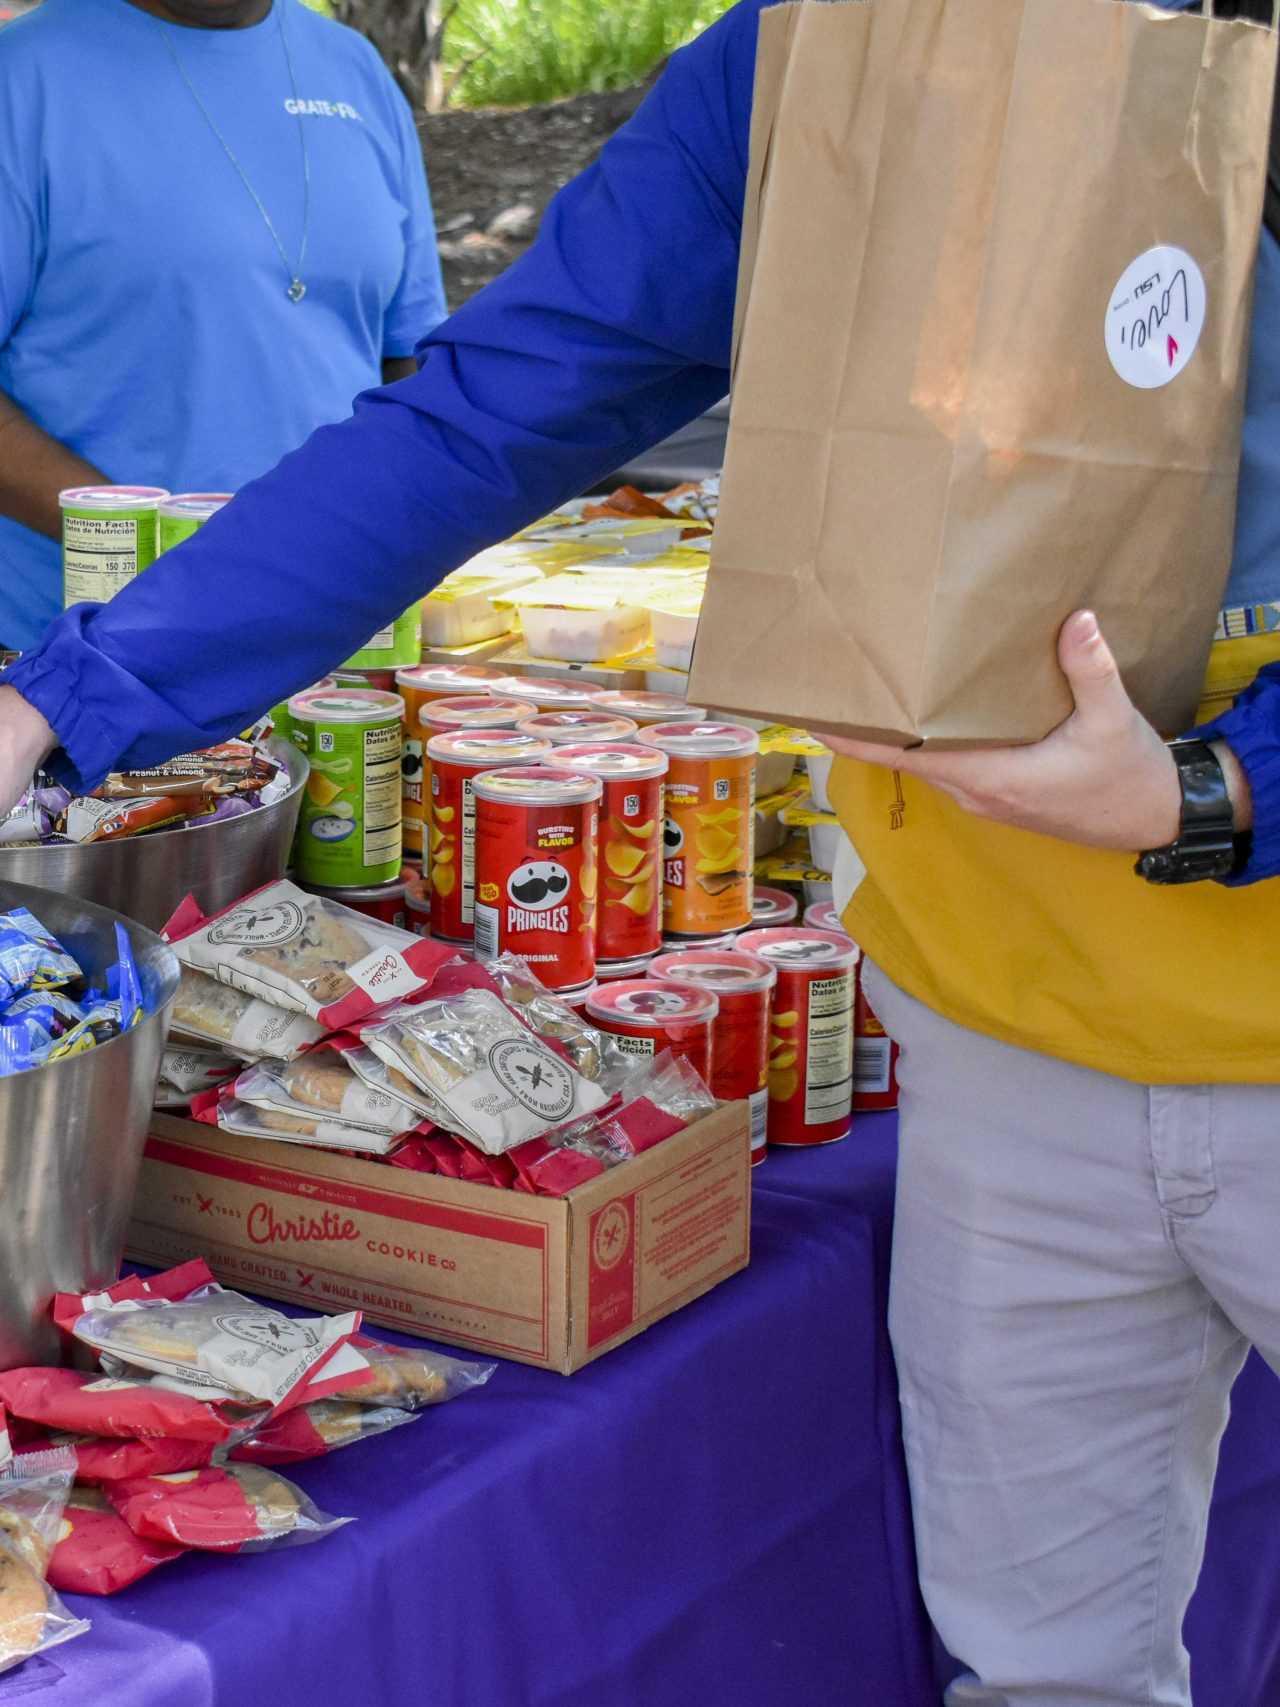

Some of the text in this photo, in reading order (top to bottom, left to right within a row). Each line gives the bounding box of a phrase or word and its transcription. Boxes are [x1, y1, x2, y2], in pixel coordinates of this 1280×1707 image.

[1133, 272, 1161, 299] LSU
[66, 518, 135, 529] Nutrition Facts
[95, 527, 135, 535] Nutrición
[106, 562, 119, 571] 150
[122, 562, 136, 571] 370
[320, 734, 333, 745] 150
[172, 768, 205, 776] Almond
[716, 780, 729, 791] 150
[626, 796, 639, 807] 150
[538, 837, 574, 848] FLAVOR
[507, 905, 569, 933] PRINGLES
[616, 1036, 652, 1047] Facts
[618, 1045, 652, 1055] trición
[246, 1201, 361, 1245] Christie
[366, 1240, 437, 1265] COOKIE
[321, 1281, 359, 1301] WHOLE
